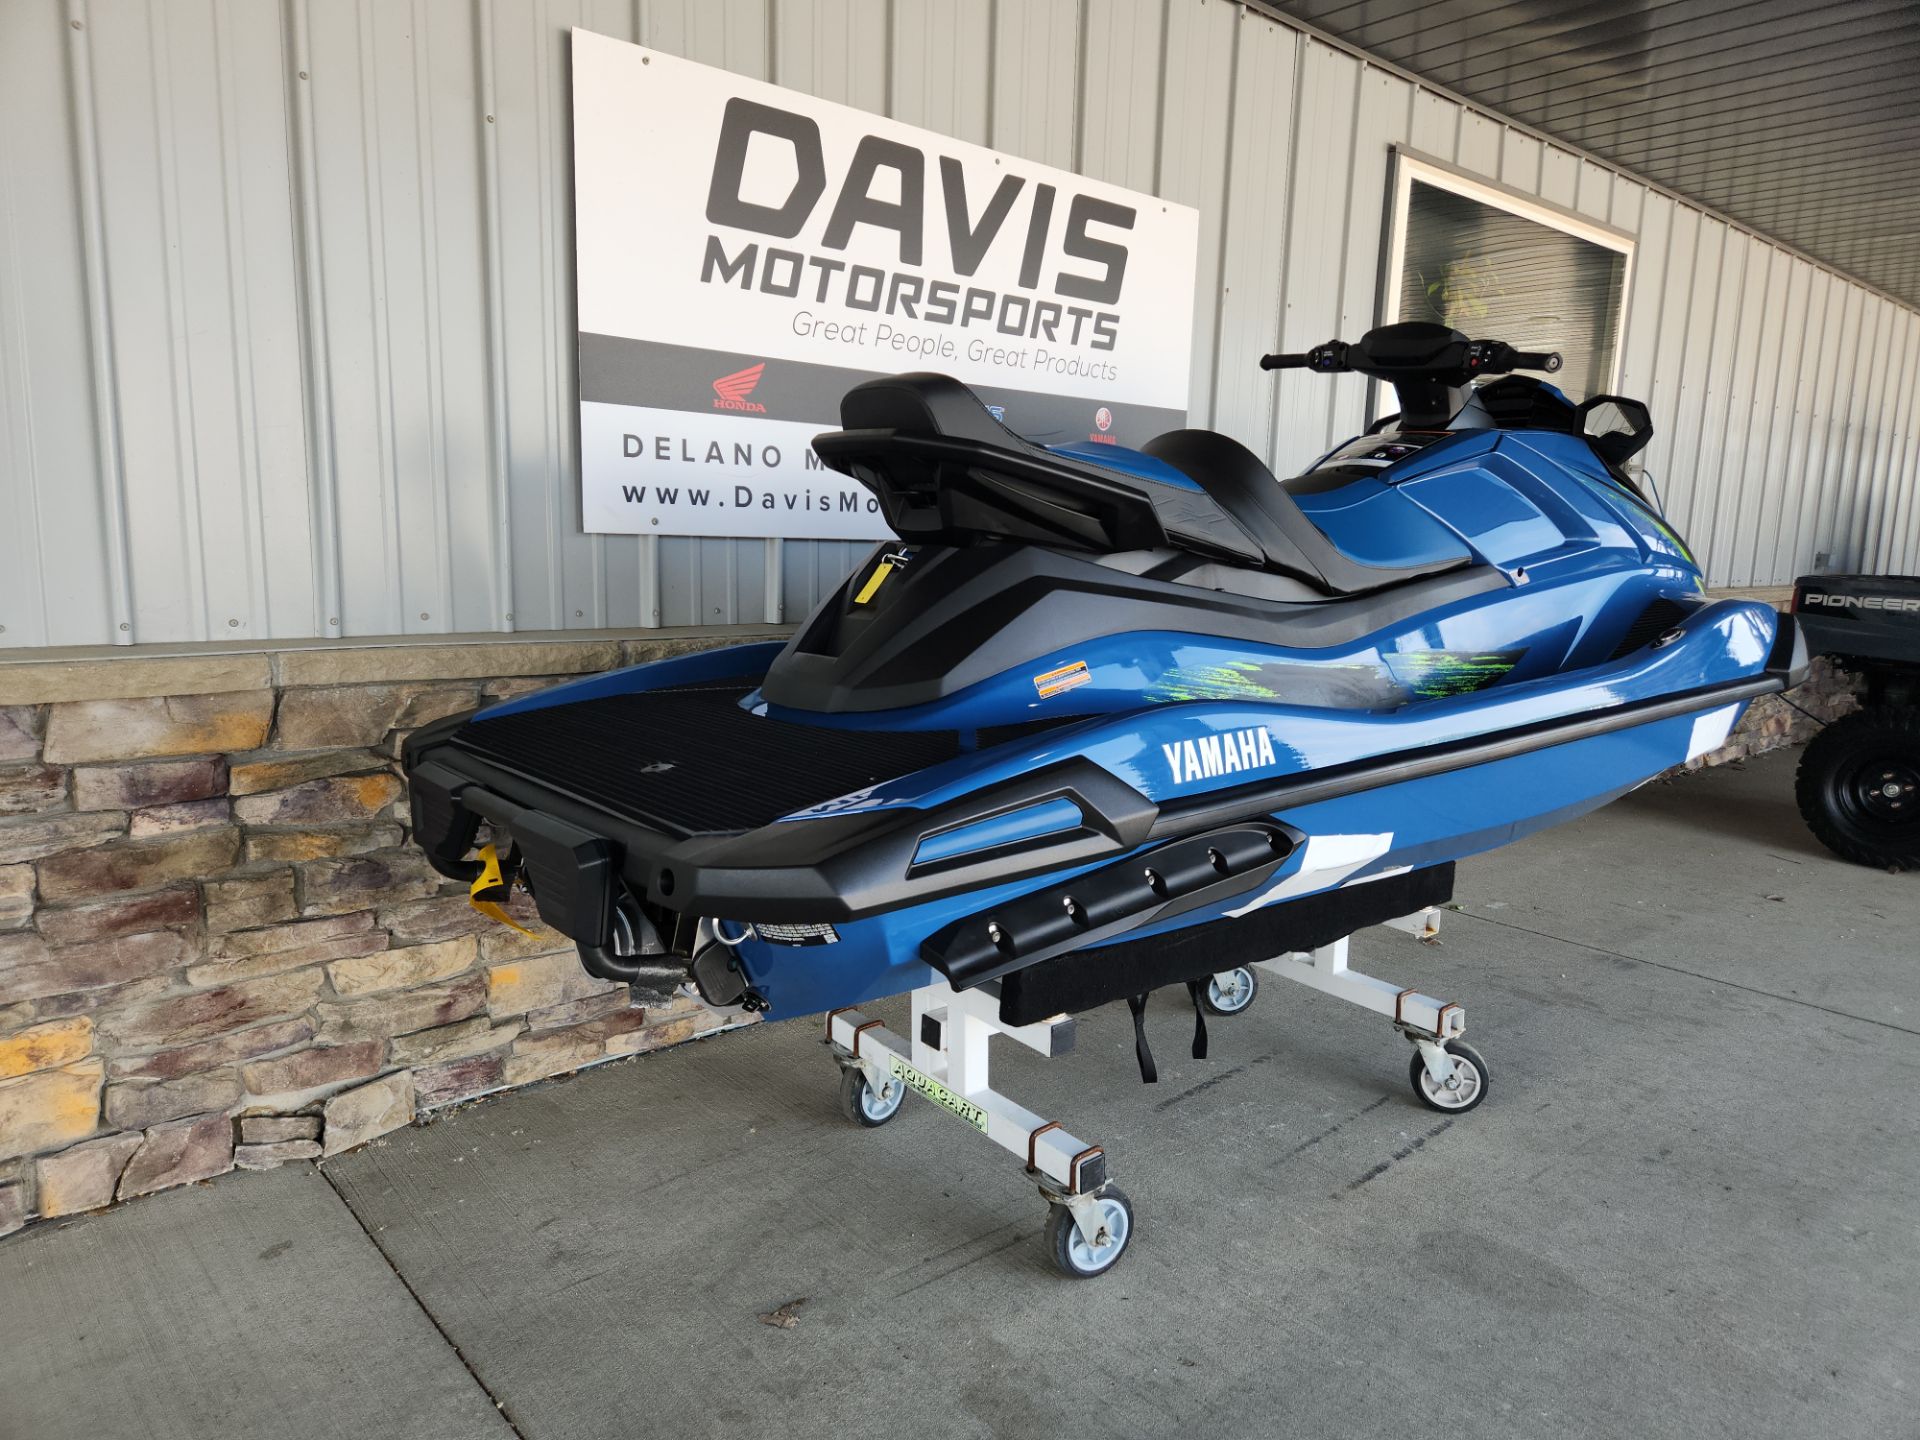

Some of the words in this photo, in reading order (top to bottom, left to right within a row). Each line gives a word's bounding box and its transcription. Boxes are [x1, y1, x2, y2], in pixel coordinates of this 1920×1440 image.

[705, 96, 1137, 305] DAVIS
[700, 234, 1121, 351] MOTORSPORTS
[792, 310, 868, 345] Great
[874, 323, 959, 360] People,
[967, 339, 1027, 369] Great
[1033, 348, 1118, 382] Products
[713, 399, 767, 413] HONDA
[622, 433, 782, 468] DELANO
[1804, 593, 1920, 612] PIONEER
[1161, 726, 1277, 785] YAMAHA
[893, 1064, 982, 1122] AQUACART
